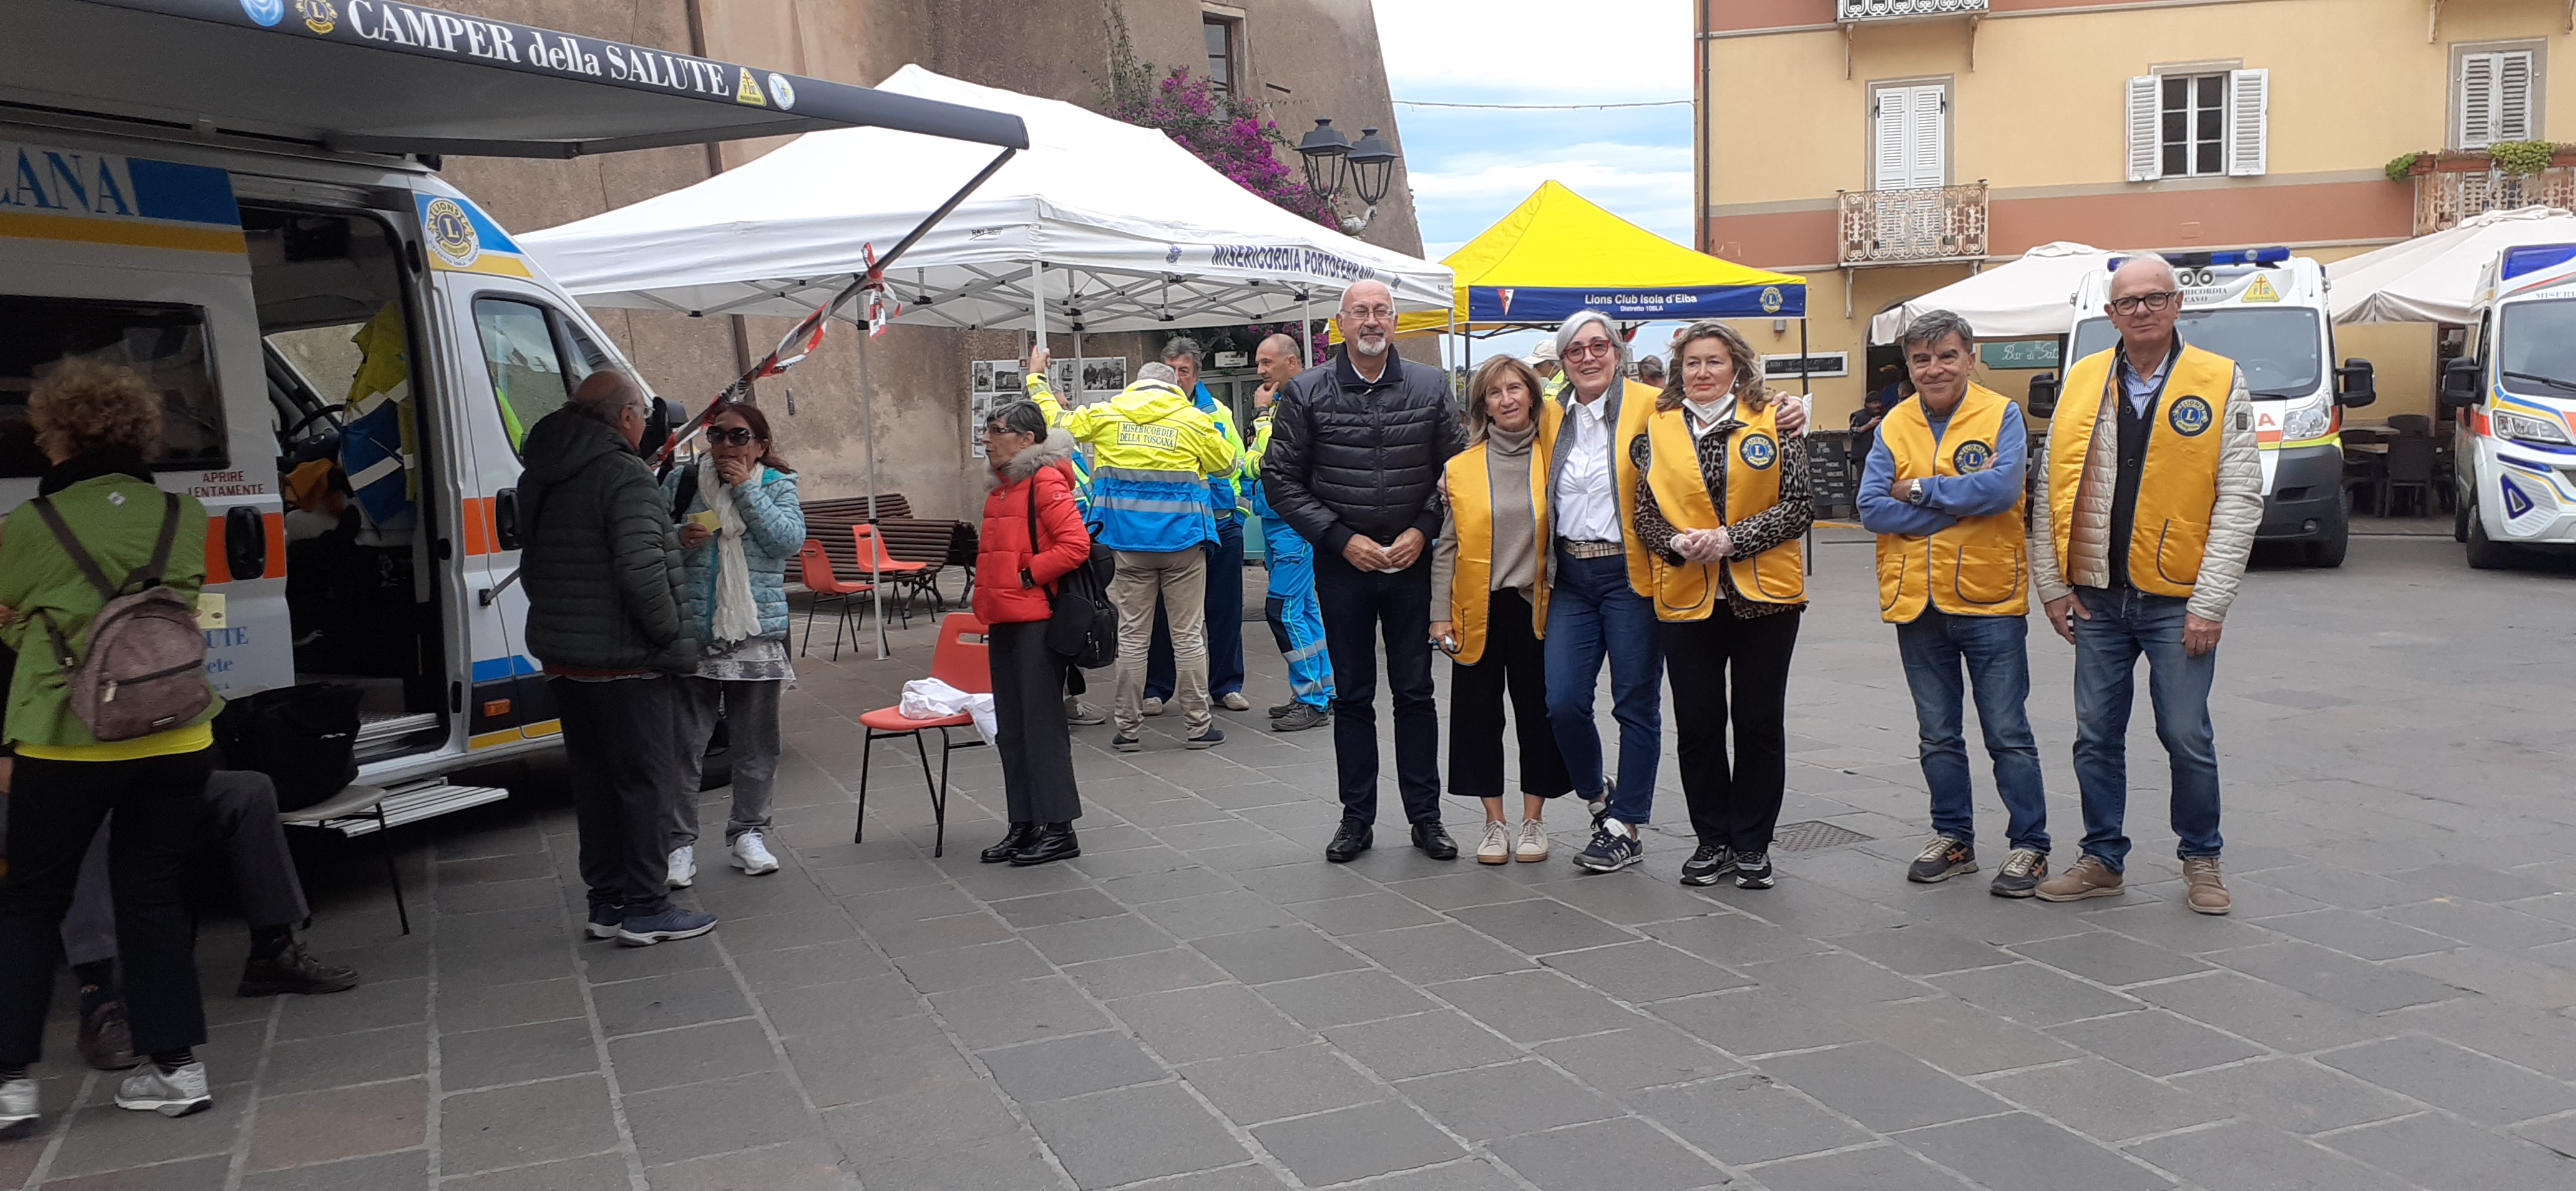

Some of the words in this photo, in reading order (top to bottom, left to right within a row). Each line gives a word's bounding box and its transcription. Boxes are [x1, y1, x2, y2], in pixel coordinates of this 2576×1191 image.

[348, 0, 521, 62] CAMPER
[529, 31, 602, 76] della
[606, 45, 729, 96] SALUTE
[0, 147, 134, 215] ANA
[432, 202, 461, 217] LIONS
[443, 218, 460, 238] L
[1211, 244, 1302, 272] MISERICORDIA
[1585, 295, 1612, 304] Lions
[1615, 294, 1638, 304] Club
[1641, 294, 1664, 304] Isola
[1666, 294, 1697, 303] d'Elba
[2002, 343, 2022, 360] Bar
[2026, 351, 2035, 360] di
[2183, 400, 2203, 409] LIONS
[2185, 409, 2195, 421] L
[2258, 413, 2276, 427] A
[1122, 424, 1174, 438] MISERICORDIE
[1120, 433, 1139, 442] DELLA
[1144, 434, 1173, 448] TOSCANA
[1755, 445, 1764, 456] L
[1969, 453, 1978, 464] L
[203, 471, 244, 483] APRIRE
